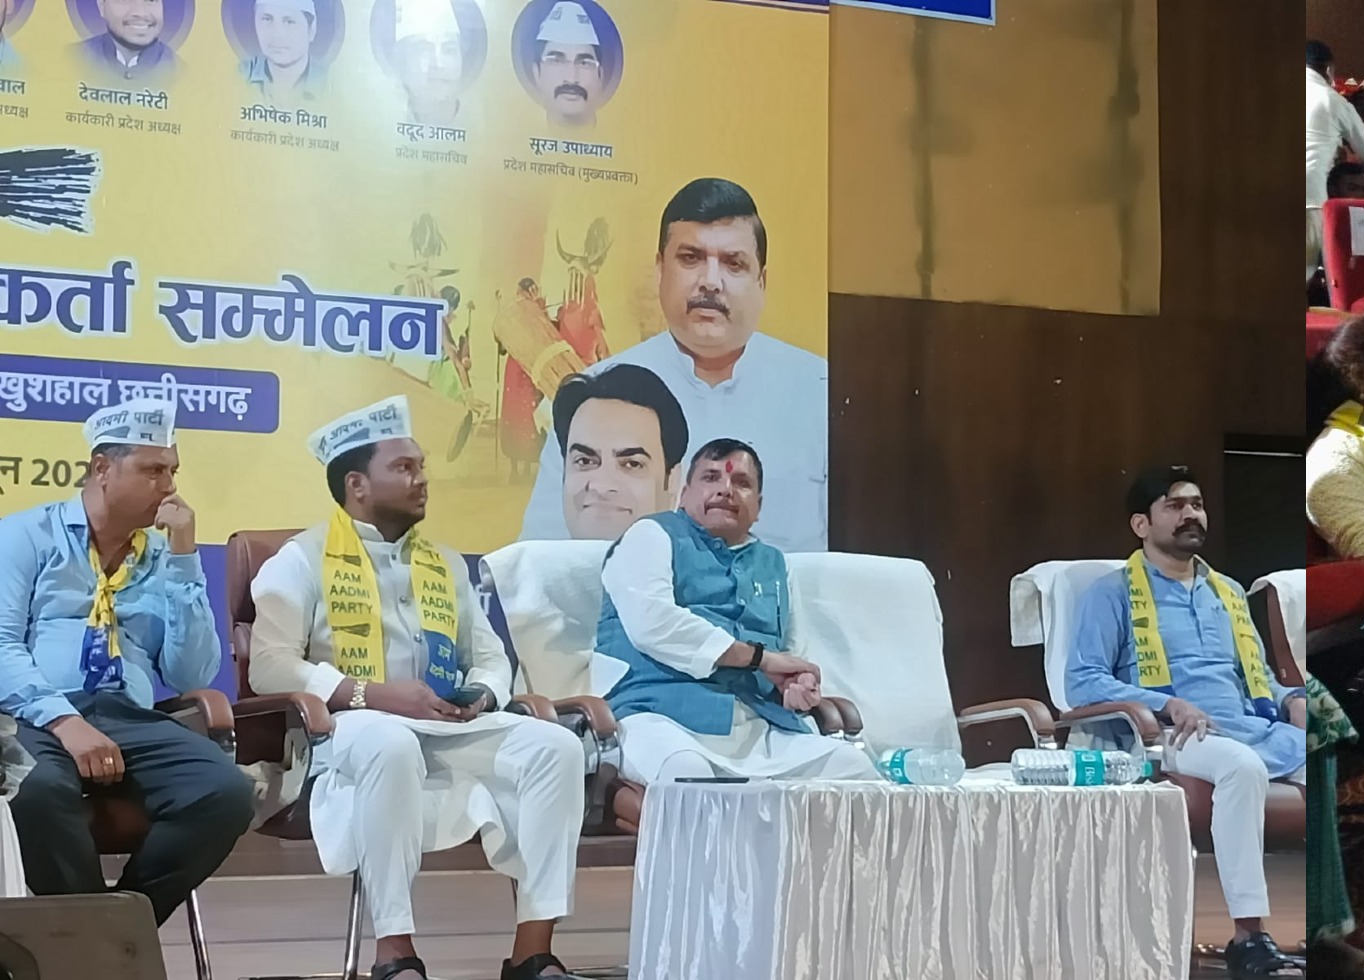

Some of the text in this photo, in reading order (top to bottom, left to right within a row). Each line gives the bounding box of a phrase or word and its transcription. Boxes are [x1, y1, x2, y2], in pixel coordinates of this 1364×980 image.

[78, 82, 168, 109] देवलाल नरेटी
[65, 110, 181, 135] कार्यकारी प्रदेश अध्यक्ष
[240, 104, 327, 128] अभिषेक मिश्रा
[230, 128, 340, 151] कार्यकारी प्रदेश अध्यक्ष
[396, 122, 466, 142] वदूद आलम
[529, 137, 613, 158] सूरज उपाध्याय
[503, 157, 527, 171] प्रदेश
[530, 162, 575, 177] महासचिव
[159, 274, 444, 356] सम्मेलन
[0, 371, 111, 412] खुशहाल
[134, 409, 165, 426] पार्टी
[30, 458, 93, 488] 202
[334, 569, 361, 583] AAM
[330, 584, 370, 598] AADMI
[422, 580, 447, 594] AAM
[331, 601, 373, 614] PARTY
[423, 609, 455, 629] PARTY
[341, 647, 368, 659] AAM
[1137, 650, 1158, 662] DMI
[338, 664, 376, 677] AADMI
[1140, 665, 1161, 676] RTY
